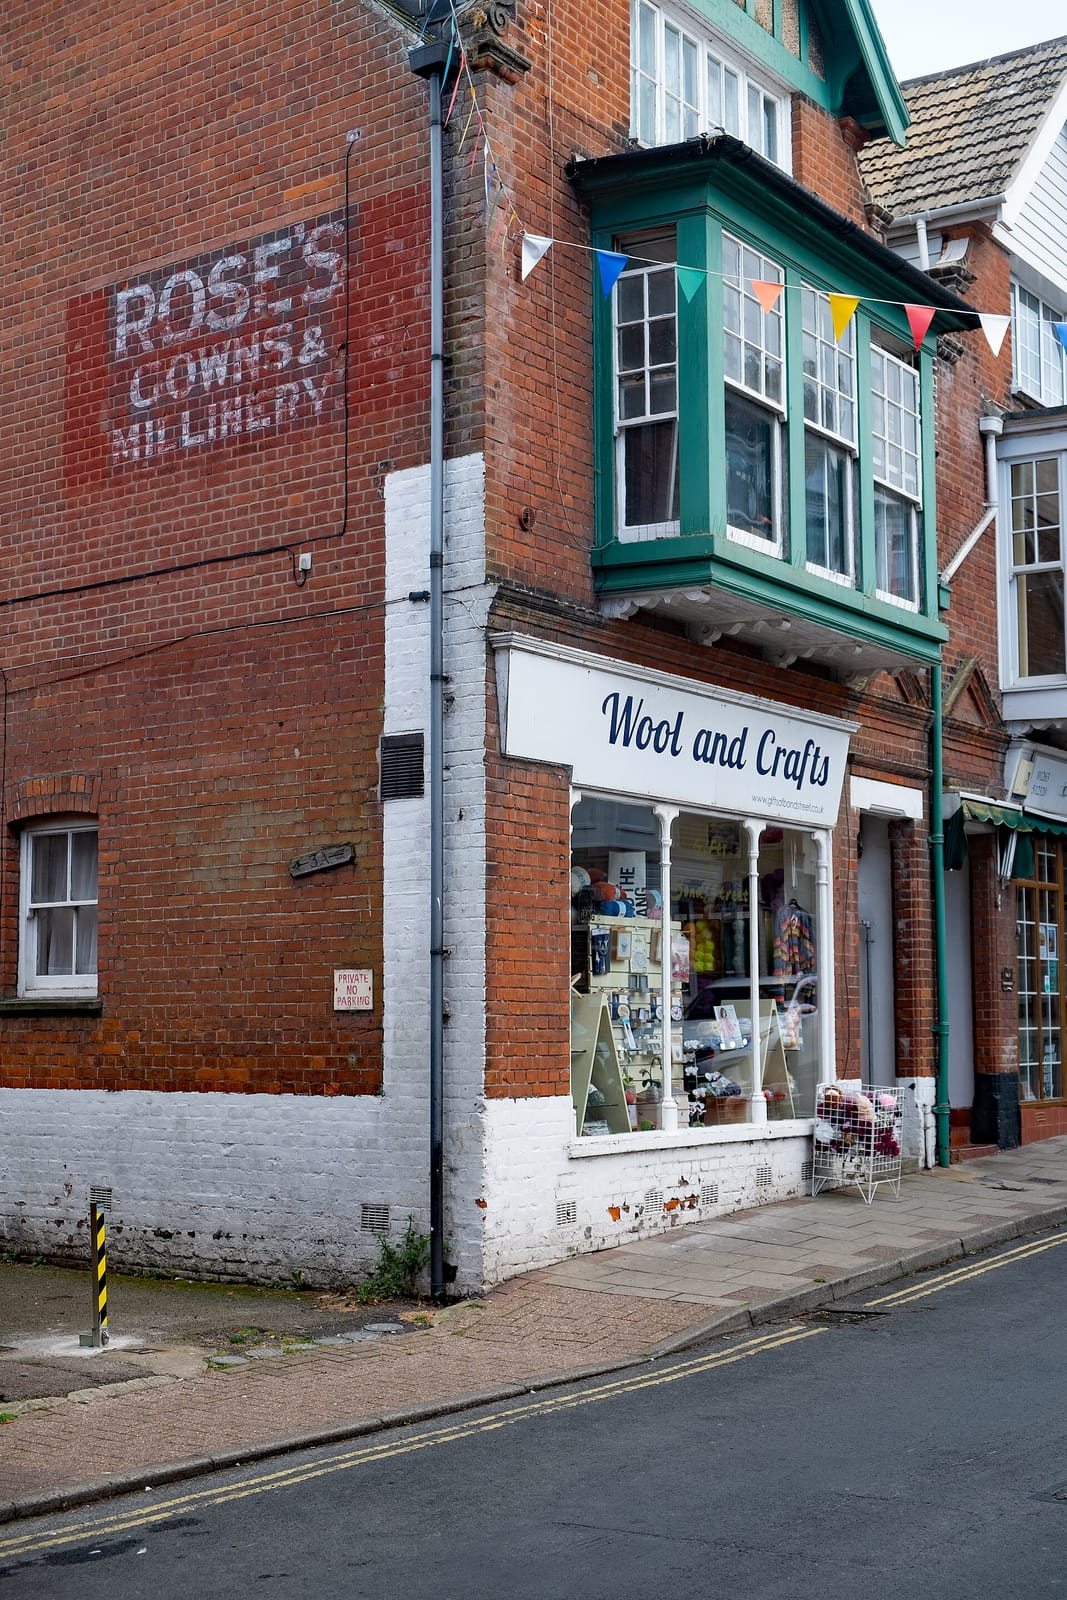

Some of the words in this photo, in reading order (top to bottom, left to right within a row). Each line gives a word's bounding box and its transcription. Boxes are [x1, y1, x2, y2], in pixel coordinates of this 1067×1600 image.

[114, 221, 347, 361] ROSE'S
[298, 325, 329, 365] &
[601, 692, 684, 757] Wool
[692, 727, 748, 770] and
[756, 729, 830, 791] Crafts
[619, 867, 635, 892] THE
[634, 887, 648, 917] ANG
[338, 973, 369, 984] PRIVATE
[346, 985, 358, 995] NO
[337, 996, 370, 1006] PARKING
